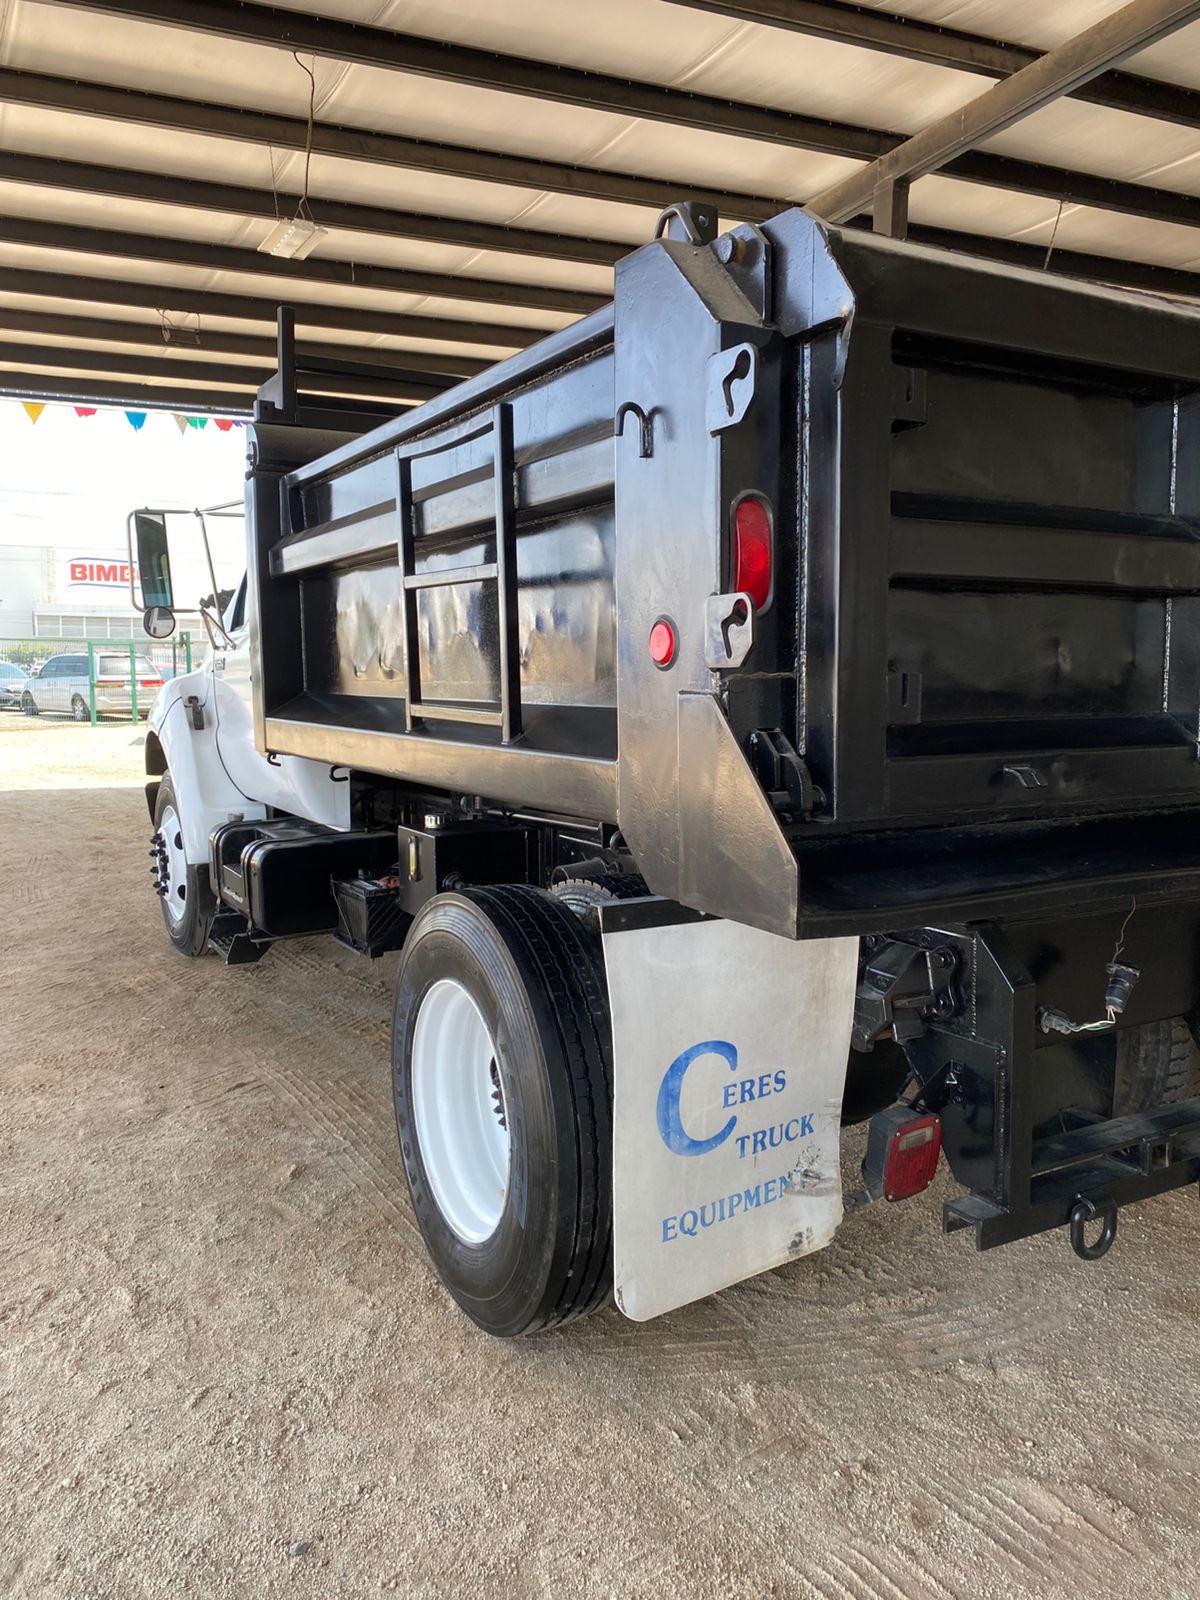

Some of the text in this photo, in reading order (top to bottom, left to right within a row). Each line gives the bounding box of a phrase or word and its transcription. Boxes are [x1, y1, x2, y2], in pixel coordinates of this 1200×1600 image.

[71, 564, 140, 582] BIMB
[657, 1040, 786, 1156] CERES
[735, 1113, 815, 1158] TRUCK
[662, 1172, 799, 1242] EQUIPMEN
